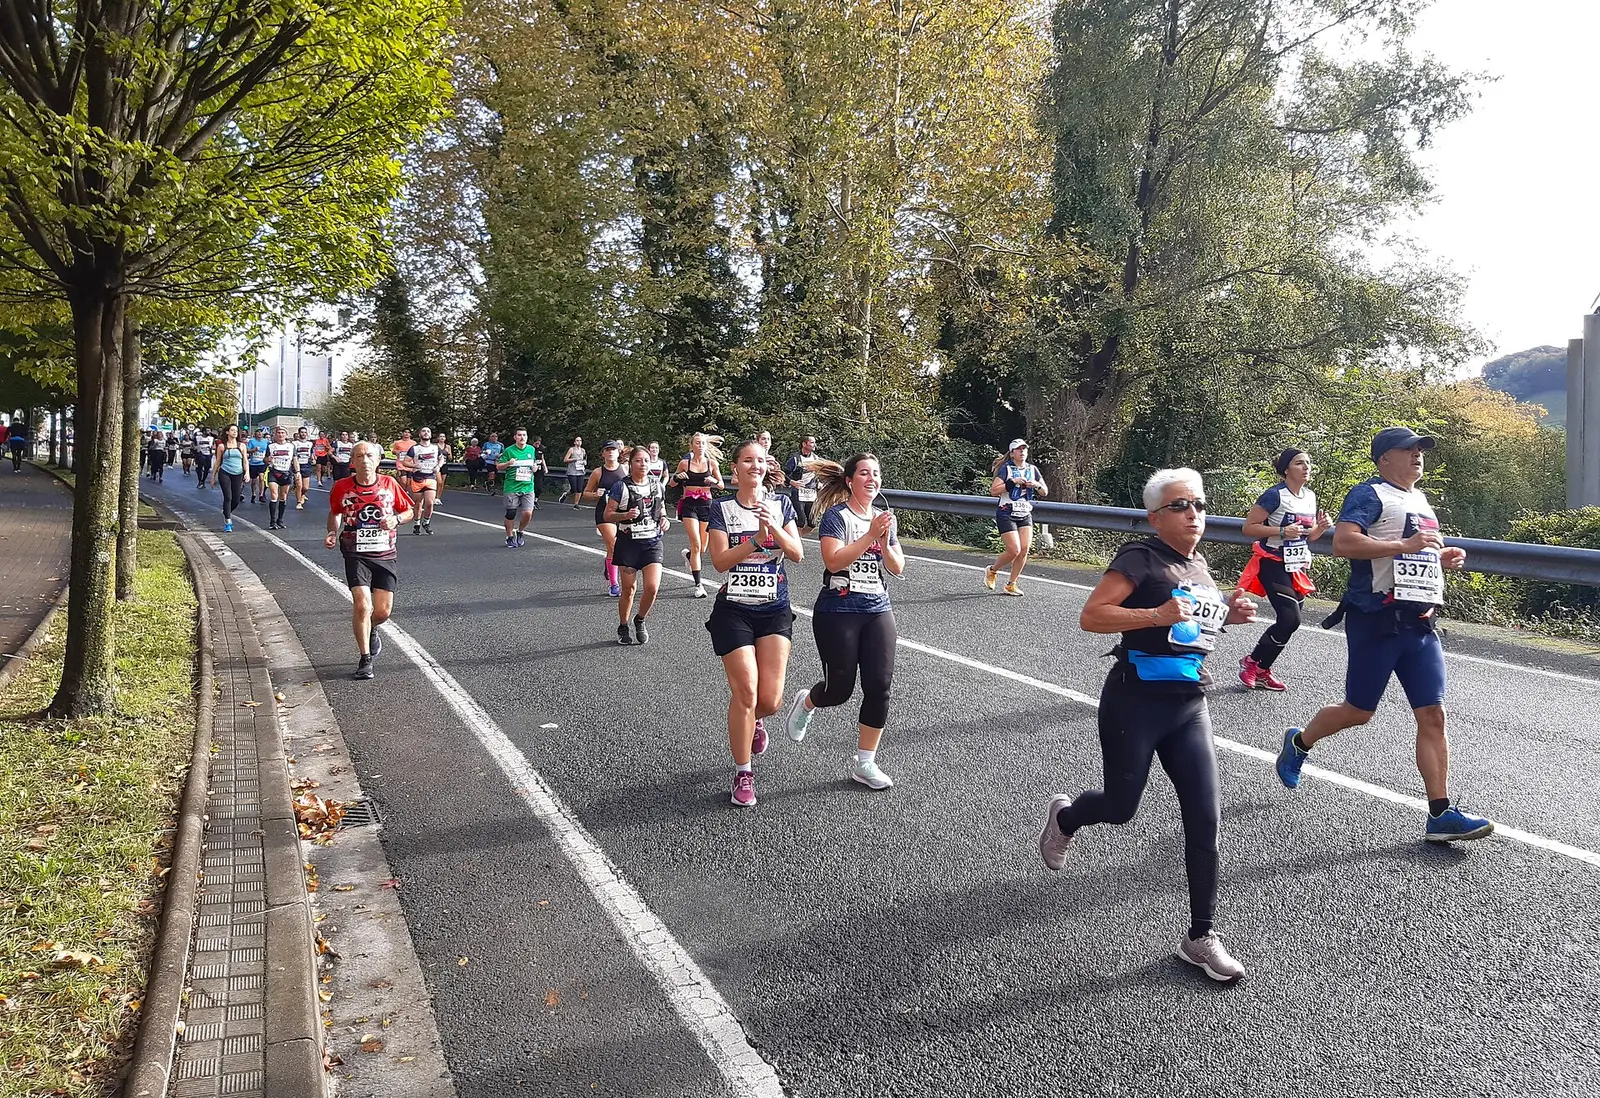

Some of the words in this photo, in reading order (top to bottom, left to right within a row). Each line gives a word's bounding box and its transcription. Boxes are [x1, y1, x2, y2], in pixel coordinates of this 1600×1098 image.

[730, 535, 739, 544] 58
[852, 561, 877, 574] 339
[1397, 562, 1439, 579] 33780
[731, 574, 775, 588] 23883
